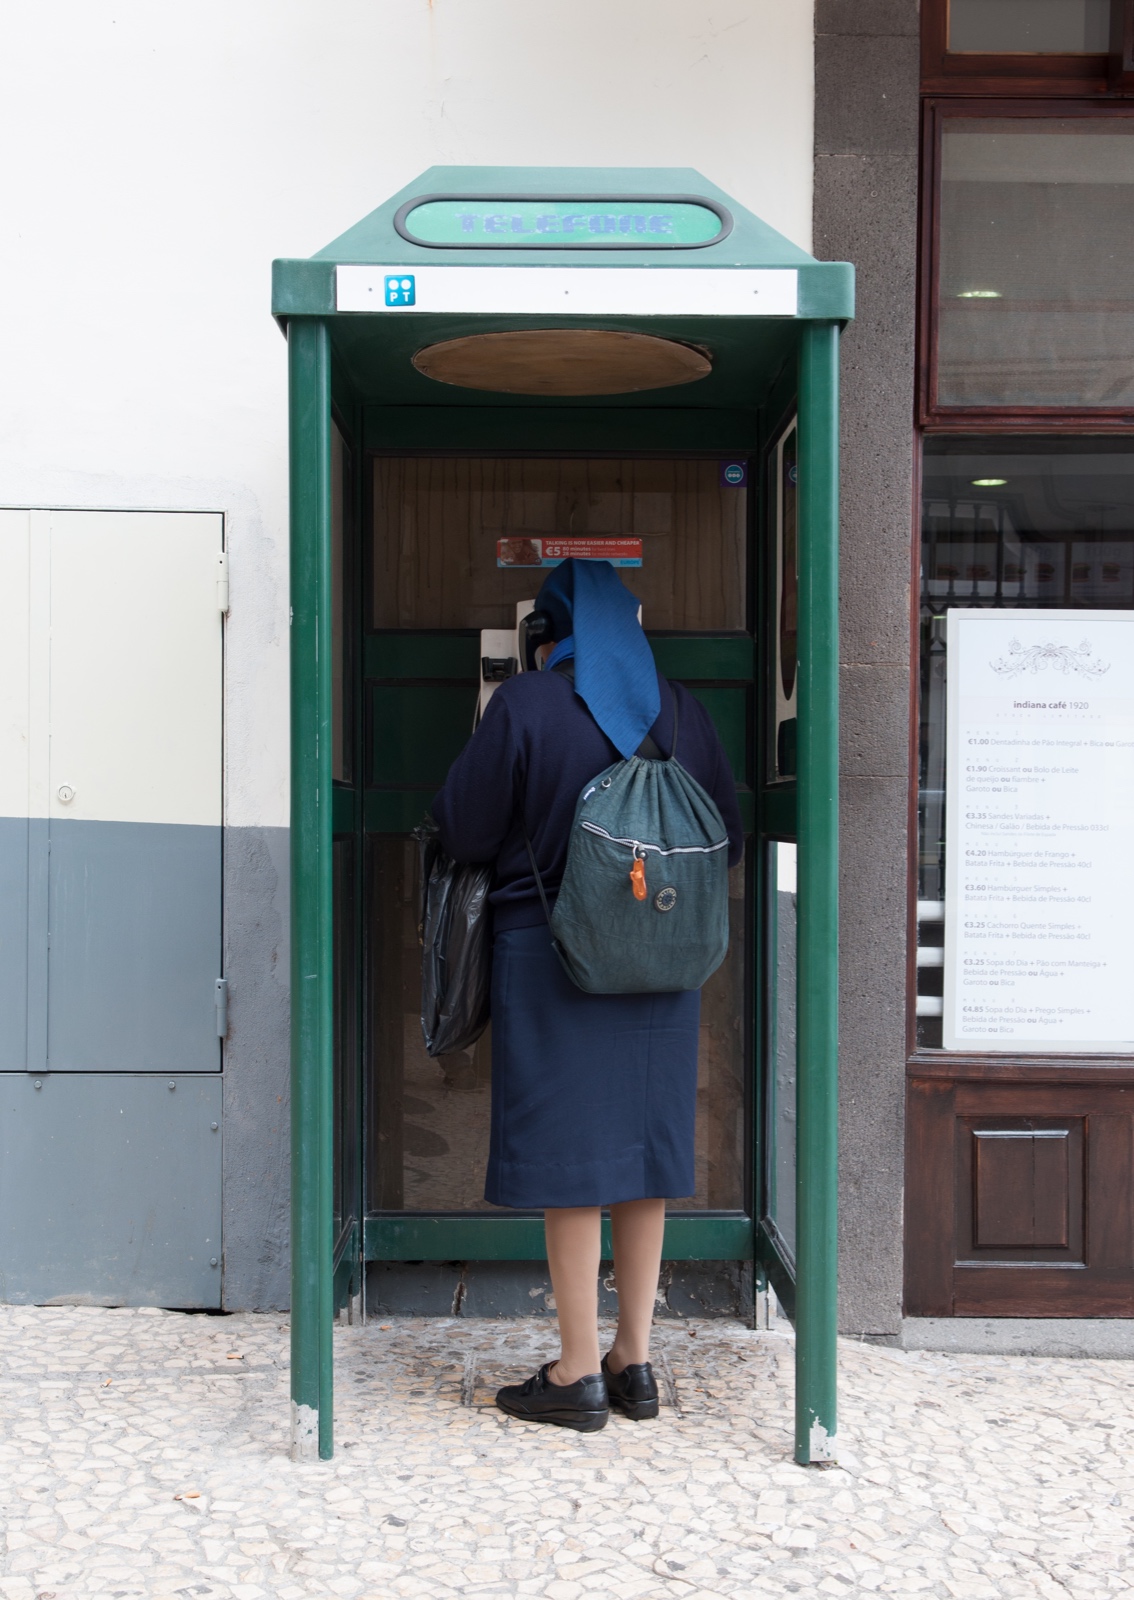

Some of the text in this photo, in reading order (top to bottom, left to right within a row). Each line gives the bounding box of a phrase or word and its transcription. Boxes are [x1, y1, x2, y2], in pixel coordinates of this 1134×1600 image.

[456, 214, 673, 234] TELEFONE
[390, 292, 410, 302] PT
[546, 546, 560, 556] €5
[1014, 700, 1089, 710] indiana café 1920
[1032, 738, 1040, 746] de
[1056, 740, 1082, 748] Integral
[1034, 766, 1050, 774] Bolo
[966, 774, 975, 782] de
[977, 776, 999, 784] queijo
[1012, 776, 1039, 784] fiambre
[966, 784, 990, 792] Garoto
[1015, 812, 1044, 820] Variadas
[966, 822, 993, 830] Chinesa
[1000, 822, 1020, 830] Galão
[1026, 822, 1050, 830] Bebida
[1063, 824, 1088, 832] Pressão
[1090, 824, 1108, 832] 033cl
[1045, 850, 1069, 860] Frango
[1013, 860, 1037, 868] Bebida
[1034, 884, 1061, 894] Simples
[965, 894, 987, 902] Batata
[1013, 894, 1036, 902] Bebida
[1049, 894, 1075, 902] Pressão
[987, 922, 1018, 930] Cachorro
[1020, 922, 1046, 930] Quente
[1048, 922, 1075, 930] Simples
[964, 930, 986, 938] Batata
[1012, 932, 1036, 940] Bebida
[1076, 932, 1090, 940] 40cl
[986, 958, 1003, 968] Sopa
[1017, 958, 1028, 966] Dia
[1068, 960, 1100, 968] Manteiga
[1000, 968, 1026, 976] Pressão
[1001, 978, 1015, 986] Bica
[985, 1006, 1002, 1014] Sopa
[1035, 1006, 1056, 1016] Prego
[1058, 1006, 1084, 1016] Simples
[988, 1016, 997, 1024] de
[999, 1016, 1025, 1024] Pressão
[1000, 1026, 1014, 1034] Bica
